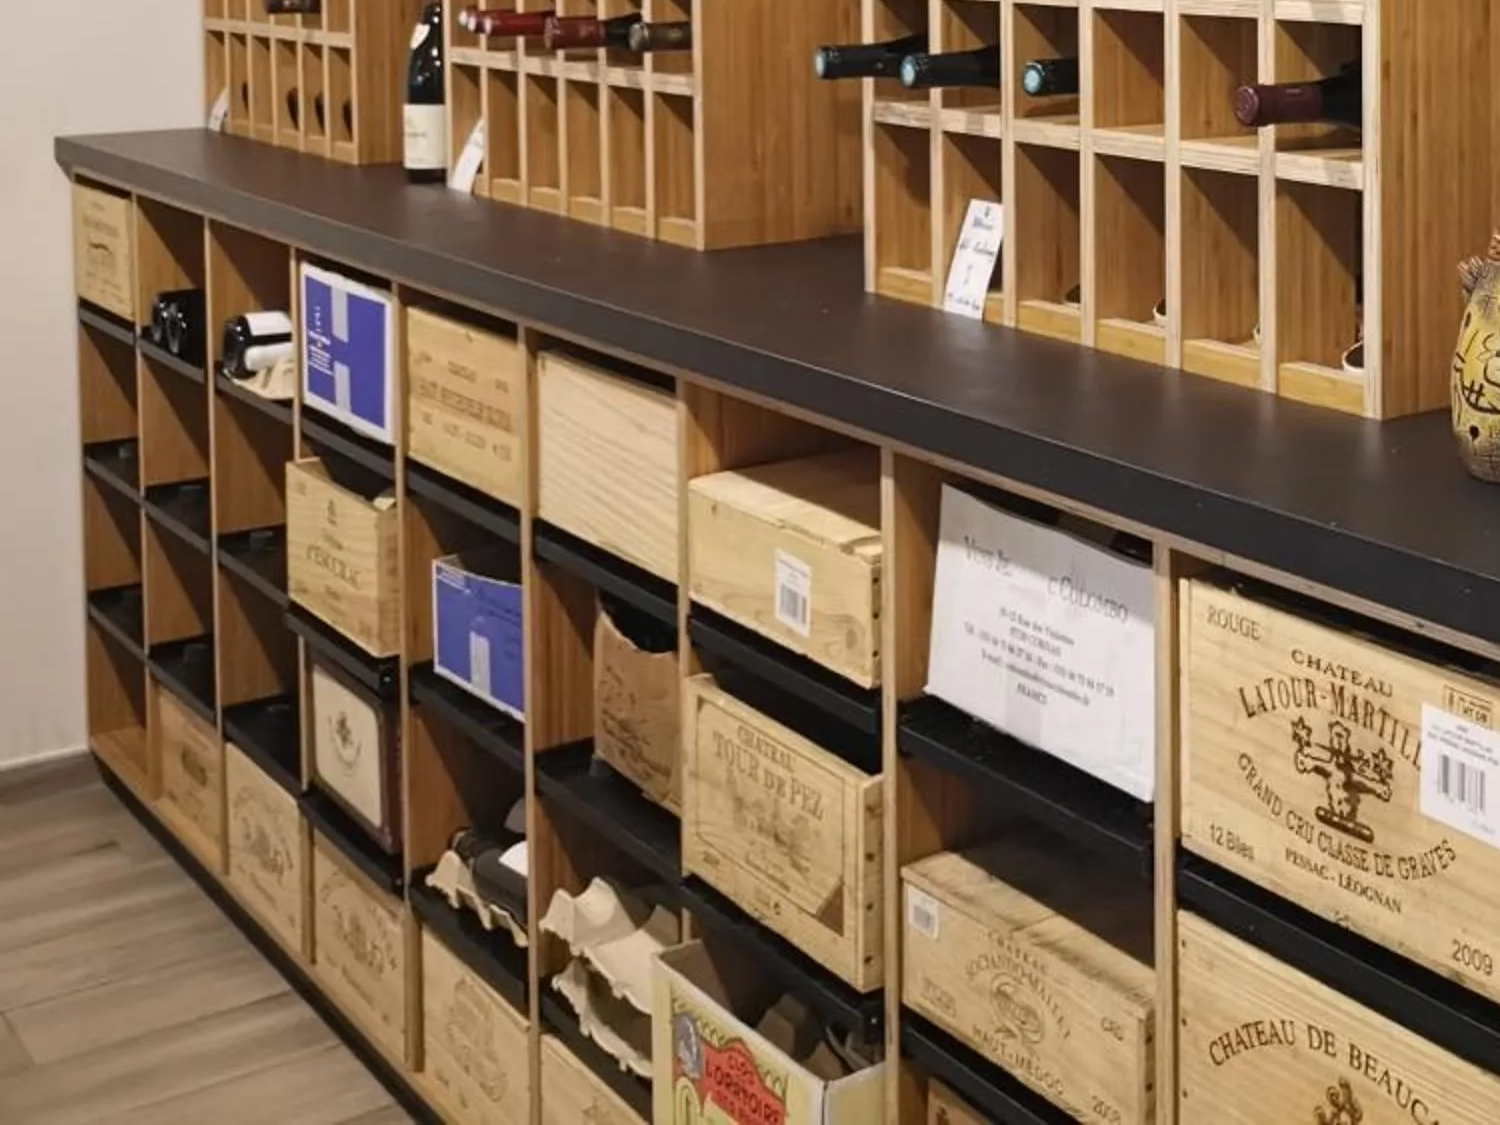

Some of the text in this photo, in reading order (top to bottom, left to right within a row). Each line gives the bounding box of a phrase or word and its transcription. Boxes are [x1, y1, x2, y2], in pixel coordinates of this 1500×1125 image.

[1206, 605, 1261, 641] ROUGE
[1291, 648, 1394, 698] CHATEAU
[713, 730, 760, 783] TOUR
[1238, 752, 1285, 817] GRAND
[1285, 810, 1315, 844] CRU
[1373, 851, 1396, 879] DE
[1397, 839, 1458, 881] GRAVES
[1451, 939, 1494, 976] 2009
[1208, 1019, 1297, 1067] CHATEAU
[1307, 1024, 1337, 1058] DE
